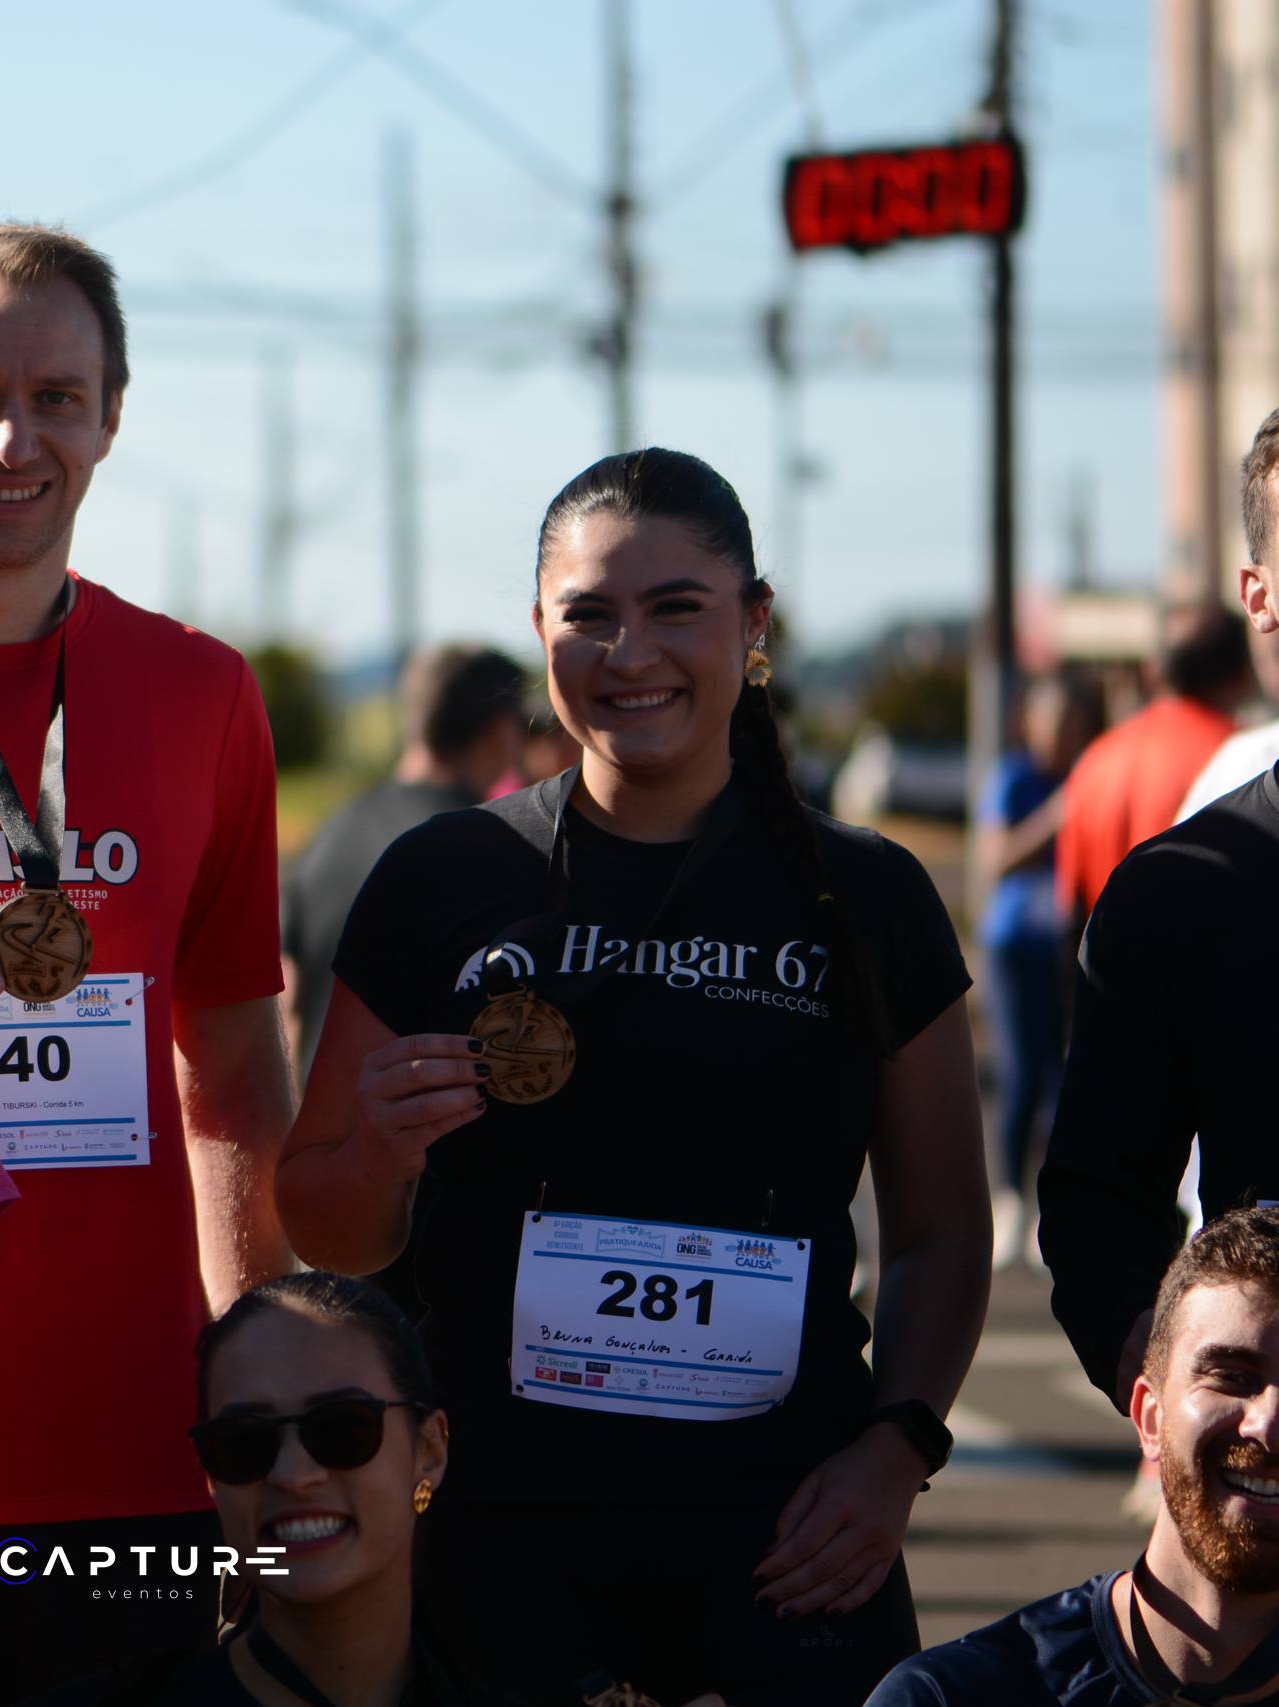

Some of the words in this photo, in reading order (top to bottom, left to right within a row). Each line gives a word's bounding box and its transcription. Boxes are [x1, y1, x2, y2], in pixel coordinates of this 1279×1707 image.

[68, 890, 108, 899] ETISMO
[556, 925, 757, 988] Hangar
[775, 941, 828, 992] 67
[704, 985, 829, 1017] CONFECÇÕES
[76, 1007, 111, 1017] CAUSA
[2, 1102, 37, 1110] TIBURSKI
[43, 1101, 67, 1109] Corrida
[599, 1238, 637, 1247] PRATIQUE
[638, 1240, 662, 1251] AJUDA
[676, 1243, 696, 1255] ONG
[735, 1257, 773, 1270] CAUSA
[596, 1270, 714, 1326] 281
[547, 1358, 578, 1369] Sicredi
[622, 1367, 649, 1376] CRESOL
